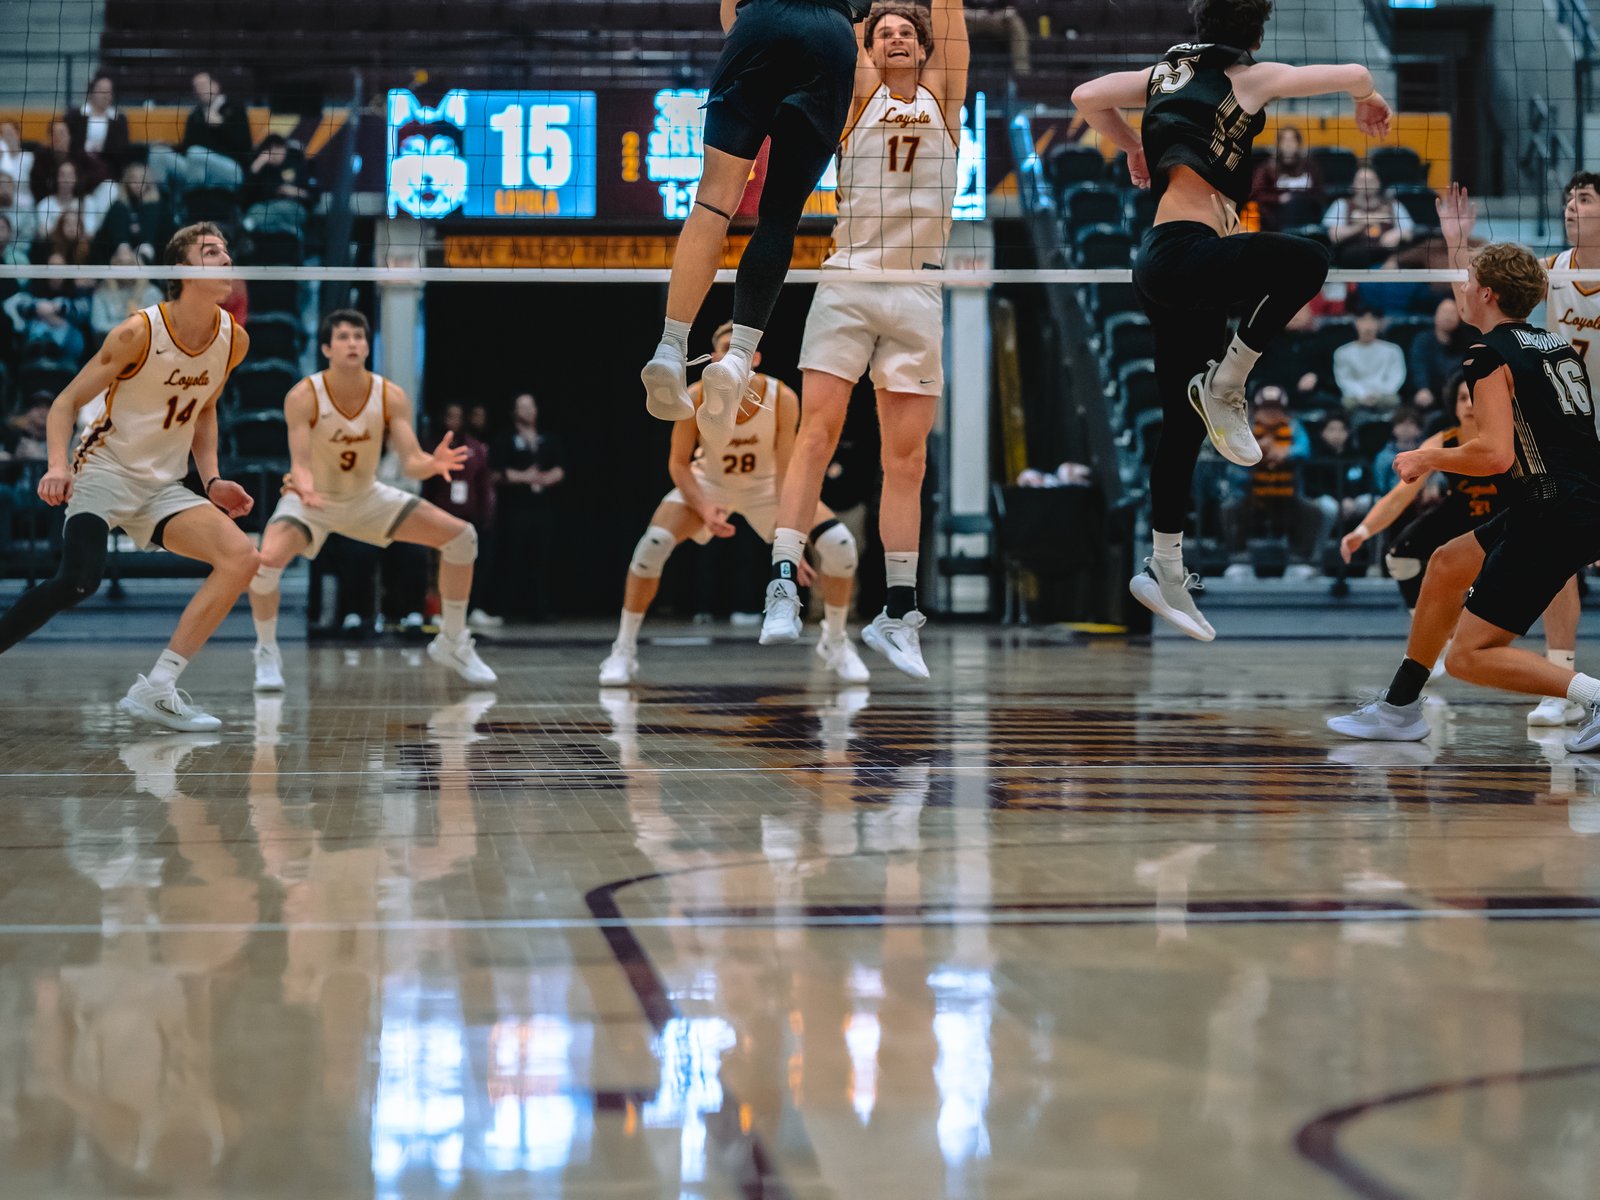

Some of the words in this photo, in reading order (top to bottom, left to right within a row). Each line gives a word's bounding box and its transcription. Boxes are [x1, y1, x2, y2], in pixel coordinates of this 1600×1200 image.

[879, 107, 931, 128] Loyola
[490, 104, 572, 189] 15
[887, 135, 920, 173] 17
[164, 369, 209, 390] Loyola
[1543, 358, 1592, 416] 16
[162, 396, 197, 429] 14
[722, 453, 756, 474] 28
